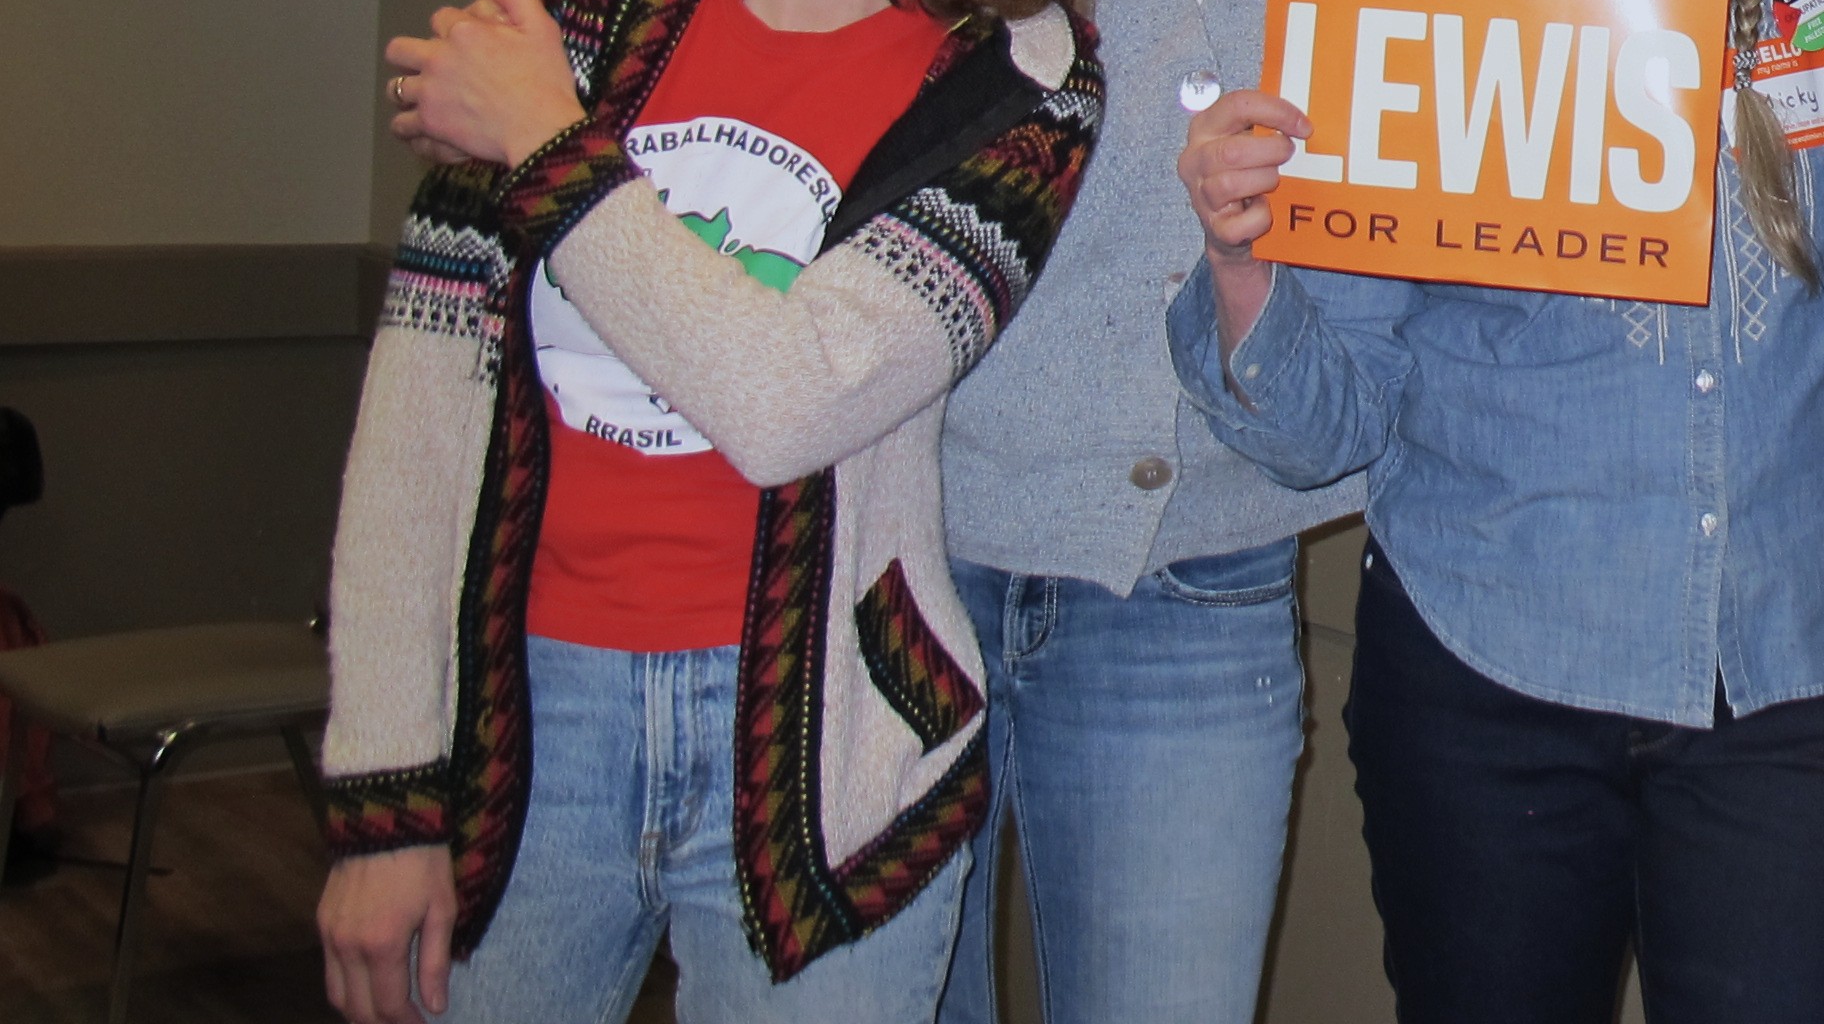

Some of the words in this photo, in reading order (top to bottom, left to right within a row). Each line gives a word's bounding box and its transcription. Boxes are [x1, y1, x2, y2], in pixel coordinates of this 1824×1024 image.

[1756, 42, 1802, 64] ELLO
[1278, 1, 1703, 214] LEWIS
[1289, 204, 1399, 245] FOR
[1435, 218, 1672, 269] LEADER
[586, 414, 682, 448] BRASIL
